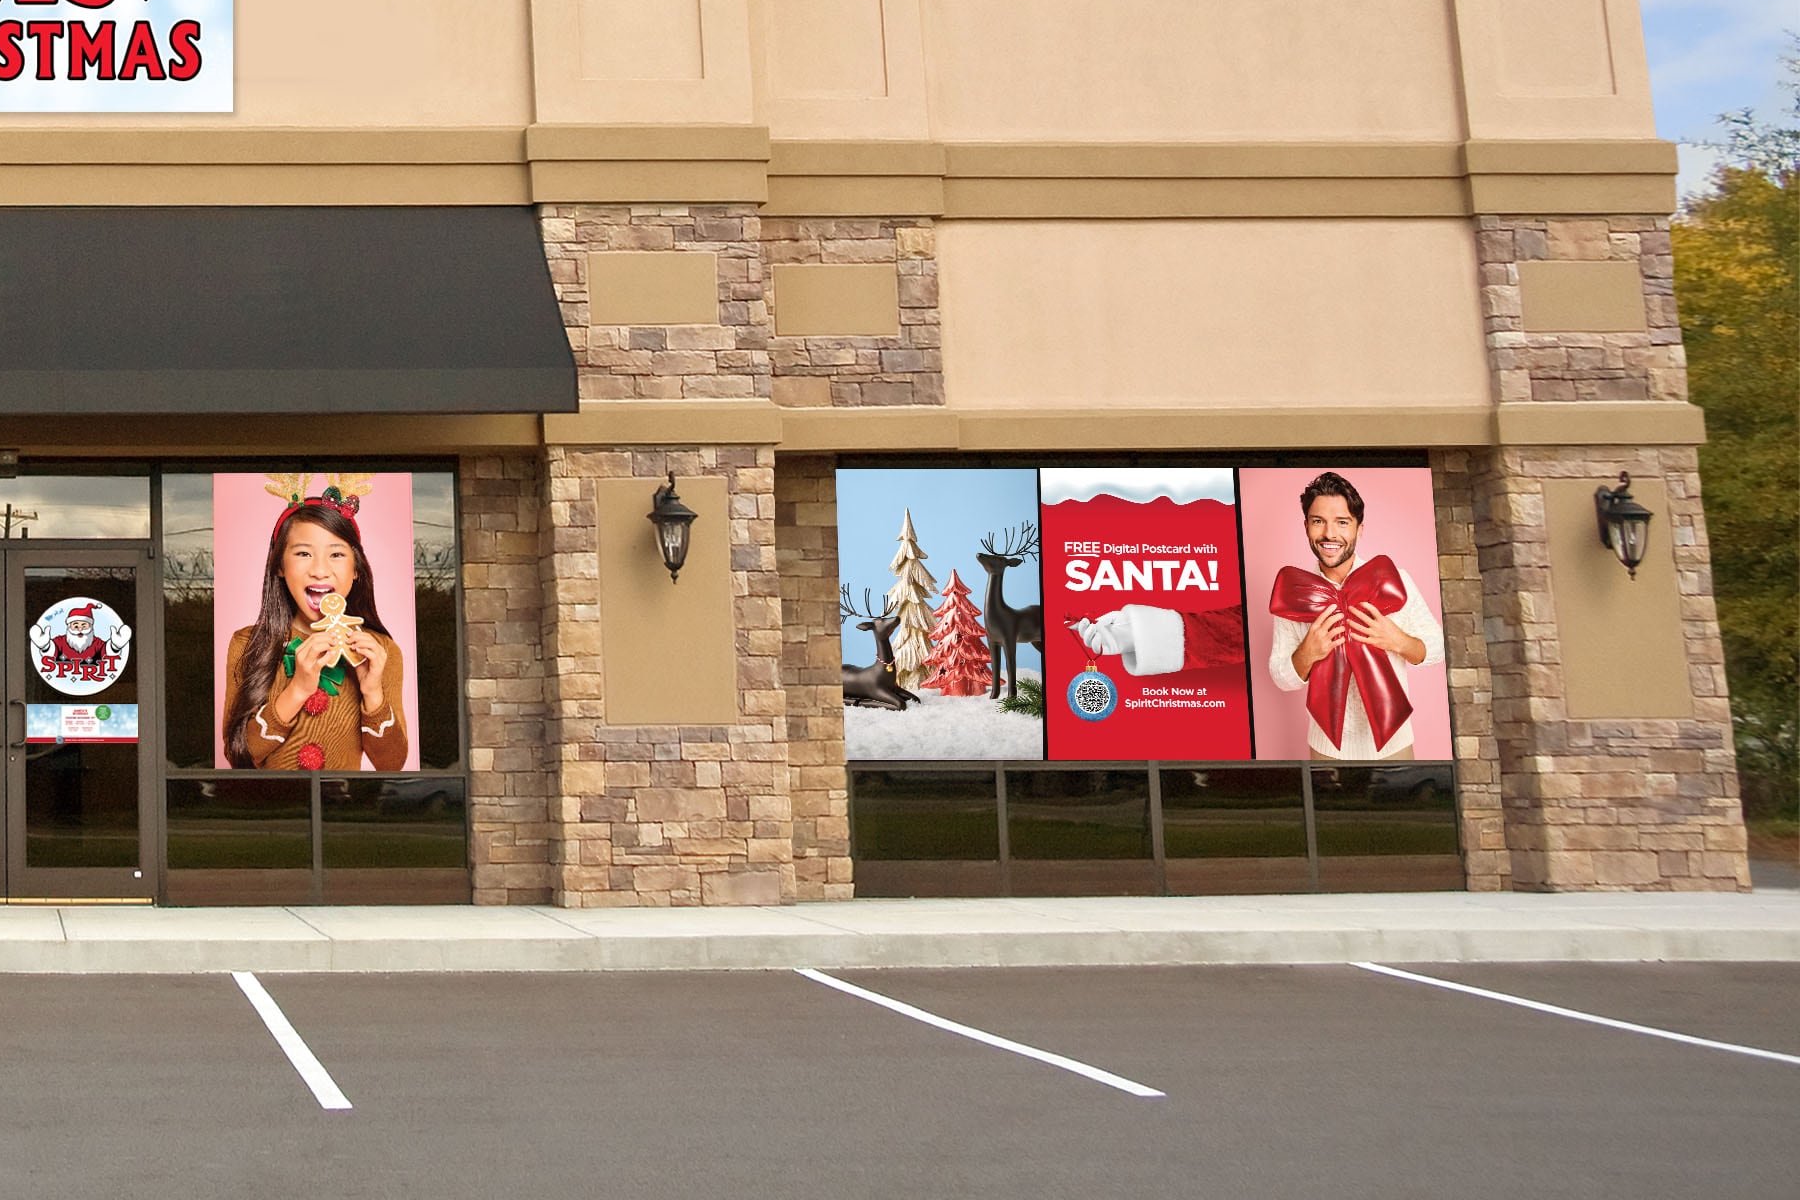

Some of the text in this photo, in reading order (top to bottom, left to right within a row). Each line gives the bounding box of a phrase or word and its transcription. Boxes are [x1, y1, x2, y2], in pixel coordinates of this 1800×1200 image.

[1064, 541, 1218, 556] FREE Digital Postcard with
[1064, 559, 1220, 592] SANTA!
[40, 654, 122, 682] SPIRIT
[1142, 686, 1208, 696] Book Now at
[1124, 698, 1226, 710] SpiritChristmas.com
